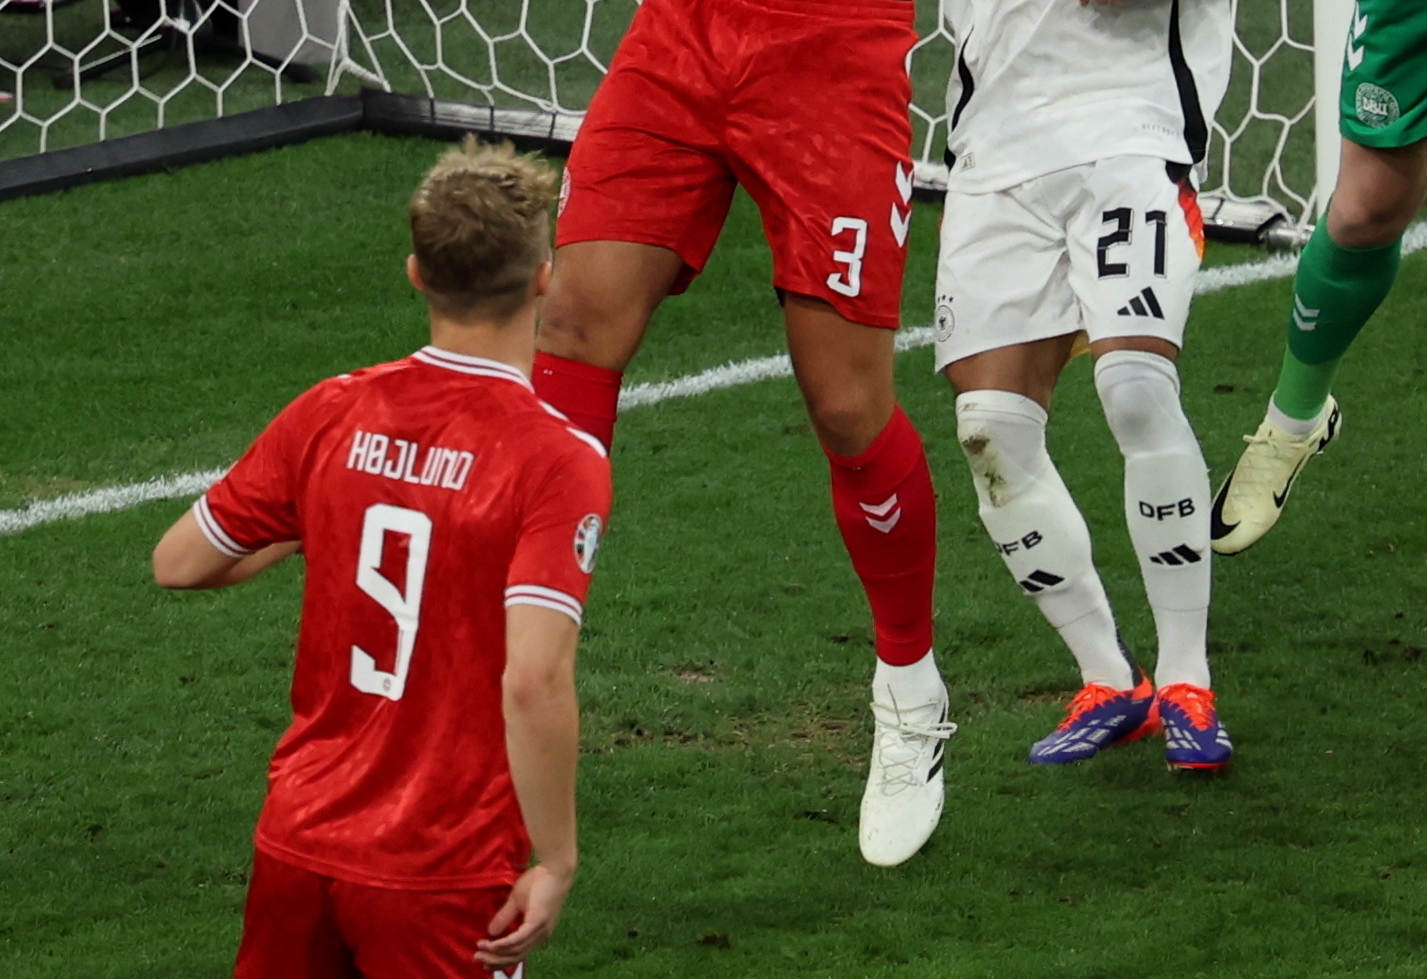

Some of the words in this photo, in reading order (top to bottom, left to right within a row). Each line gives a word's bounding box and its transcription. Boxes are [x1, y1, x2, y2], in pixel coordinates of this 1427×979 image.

[826, 217, 867, 297] 3
[1097, 207, 1167, 278] 21
[347, 429, 474, 491] HØJLUND
[1139, 498, 1195, 520] DFB
[351, 504, 432, 701] 9
